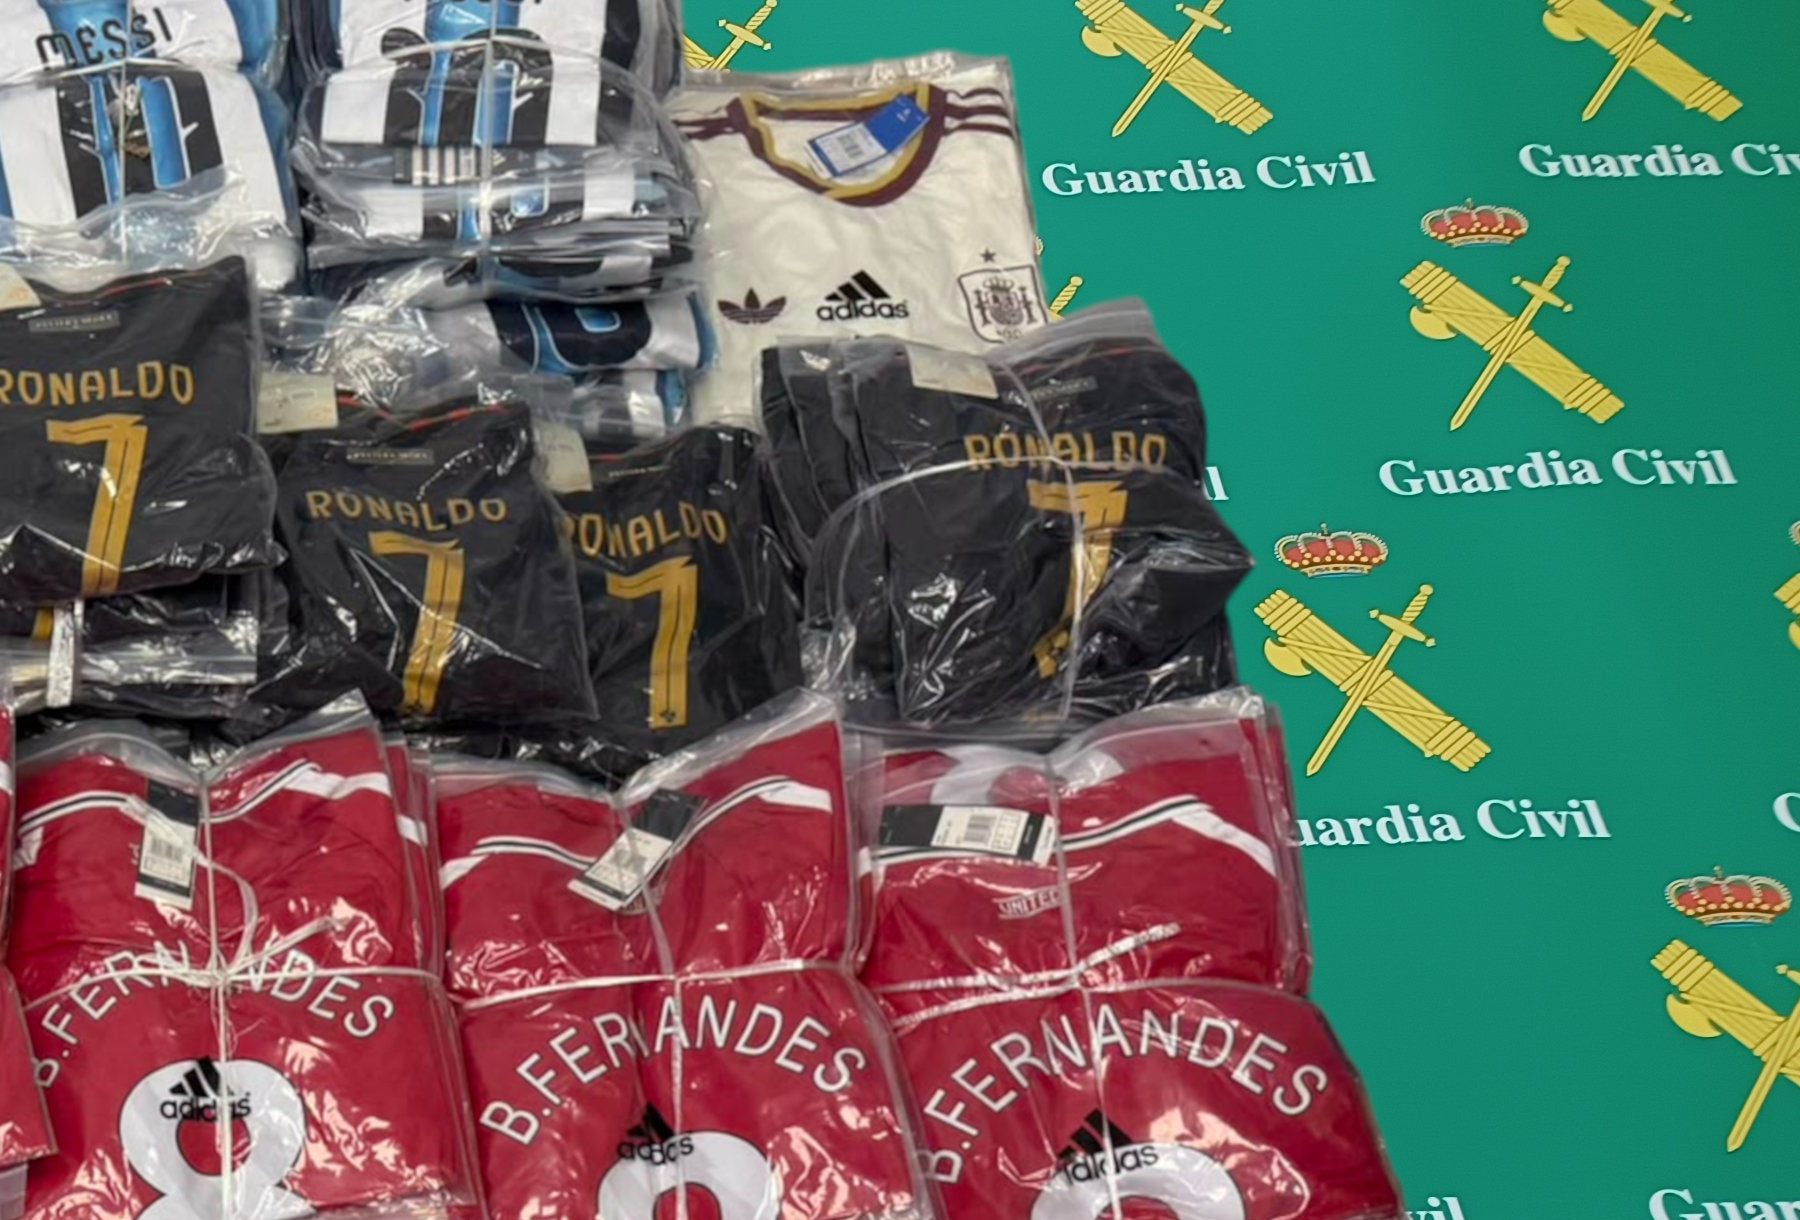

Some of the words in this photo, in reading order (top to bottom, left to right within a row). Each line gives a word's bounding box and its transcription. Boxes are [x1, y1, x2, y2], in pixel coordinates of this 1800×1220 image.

[36, 7, 172, 71] MESSI
[1042, 158, 1245, 196] Guardia
[1256, 151, 1376, 190] Civil
[1518, 143, 1722, 180] Guardia
[816, 297, 910, 322] adidas
[1379, 451, 1603, 497] Guardia
[1612, 449, 1739, 486] Civil
[46, 413, 149, 597] 7
[306, 489, 508, 533] RONALDO
[368, 531, 464, 717] 7
[606, 555, 698, 730] 7
[1288, 804, 1466, 847] uardia
[1476, 798, 1613, 839] Civil
